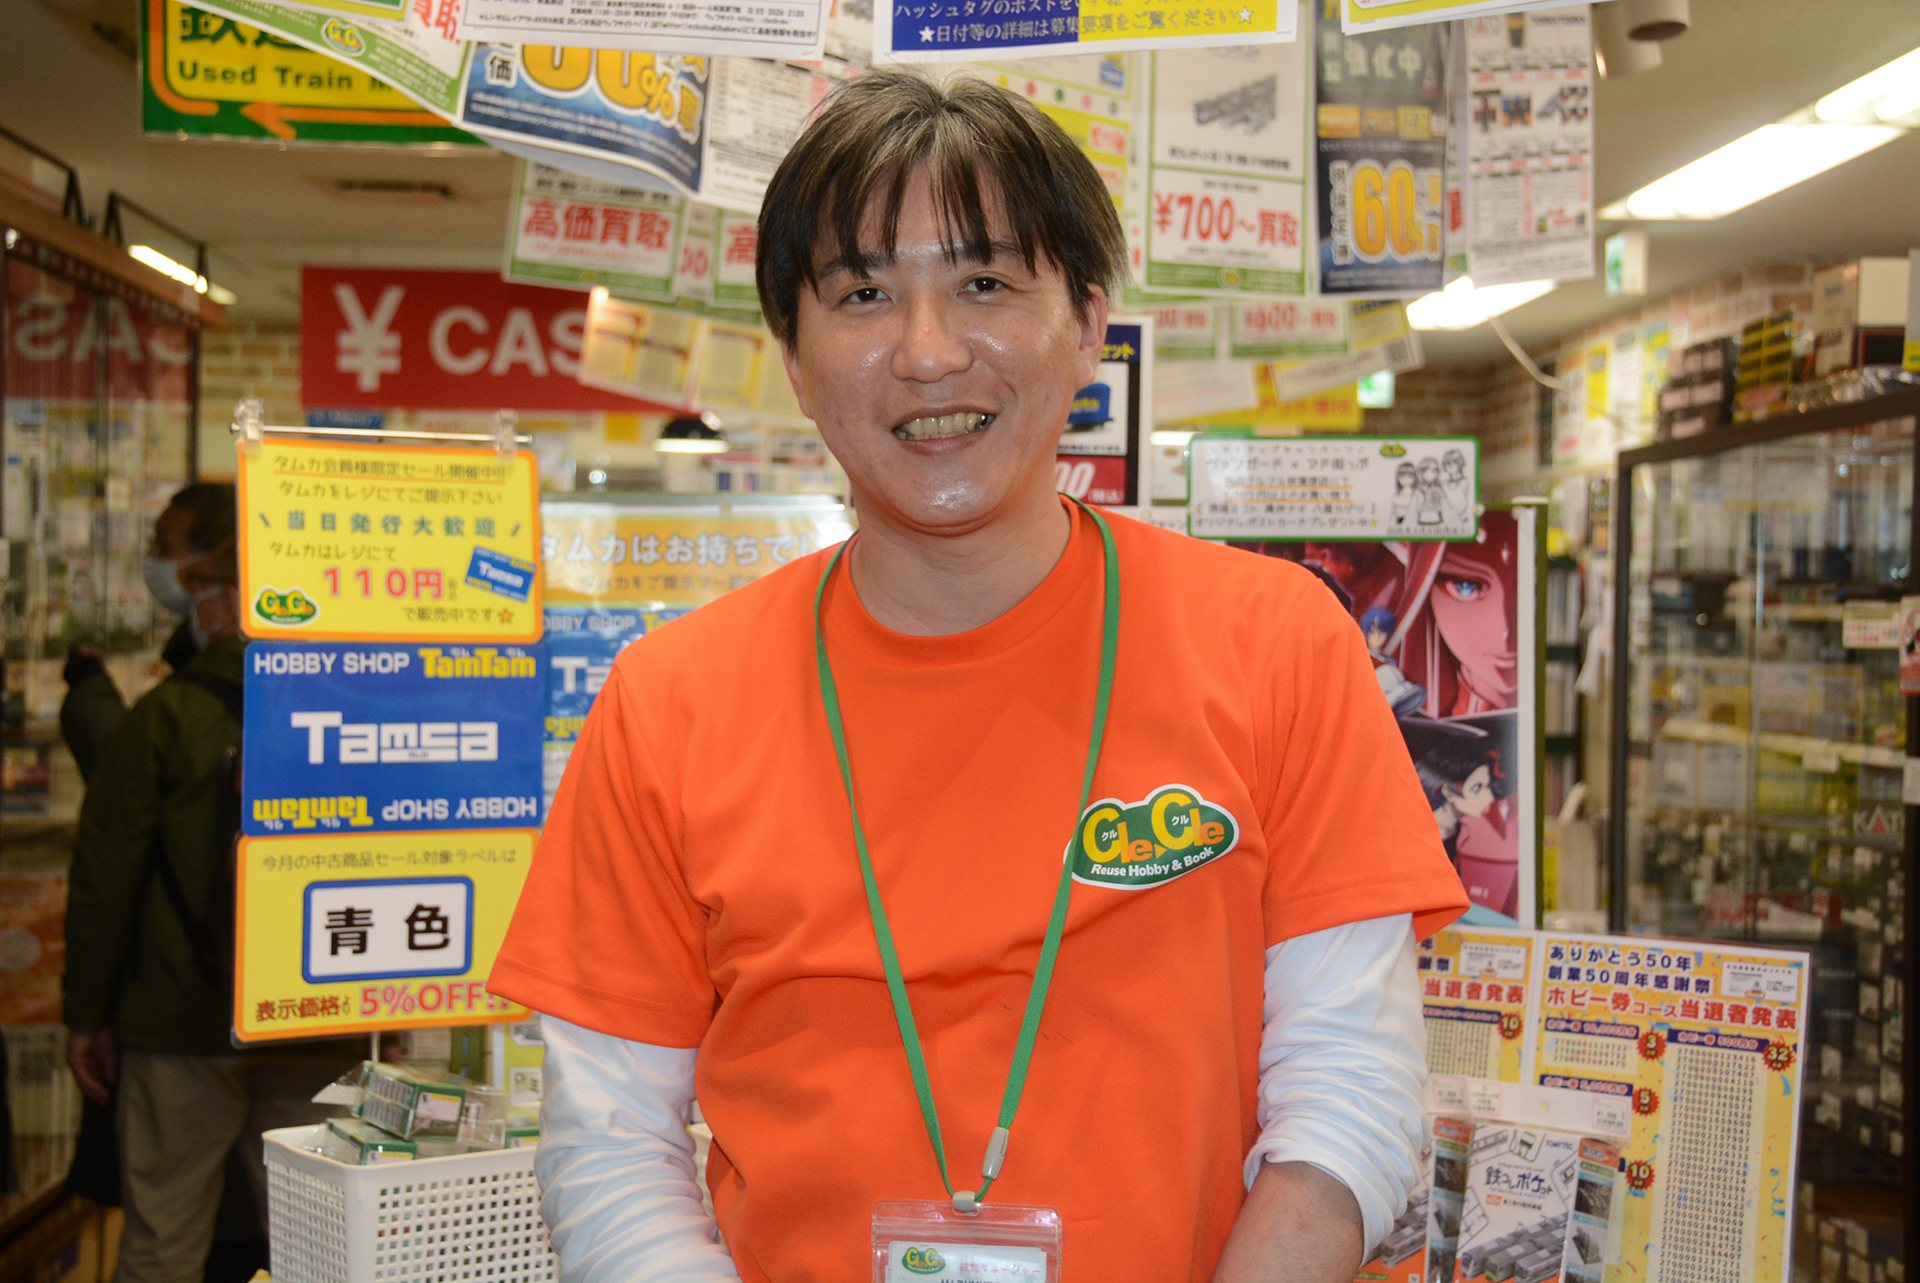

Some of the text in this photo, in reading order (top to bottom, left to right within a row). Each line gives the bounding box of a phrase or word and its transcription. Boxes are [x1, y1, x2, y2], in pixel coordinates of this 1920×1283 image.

[178, 60, 257, 85] Used
[275, 65, 354, 92] Train
[523, 196, 672, 251] 高価買取
[333, 283, 405, 393] ¥
[268, 541, 397, 562] タムカはレジにて
[322, 566, 445, 601] 110円
[586, 613, 637, 632] SHOP
[254, 648, 537, 679] HOBBY SHOP TamTam
[252, 796, 538, 829] HOBBY SHOP TamTam
[1101, 814, 1190, 842] クル クル
[261, 848, 518, 872] 今月の中古商品セール対象ラベルは
[1091, 847, 1215, 877] Reuse Hobby & Book
[324, 903, 452, 957] 青色
[1549, 944, 1693, 973] ありがとう50年
[1424, 977, 1525, 1005] 当選者発表
[1546, 964, 1712, 995] 創業50周年感謝祭
[255, 996, 341, 1022] 表示価格
[1546, 986, 1798, 1031] ホビー券コース当選者発表
[1501, 1015, 1520, 1031] 10
[1644, 1032, 1658, 1049] 3
[1766, 1045, 1791, 1062] 32
[1545, 1139, 1574, 1151] TOMYTEC
[1628, 1163, 1650, 1181] 10
